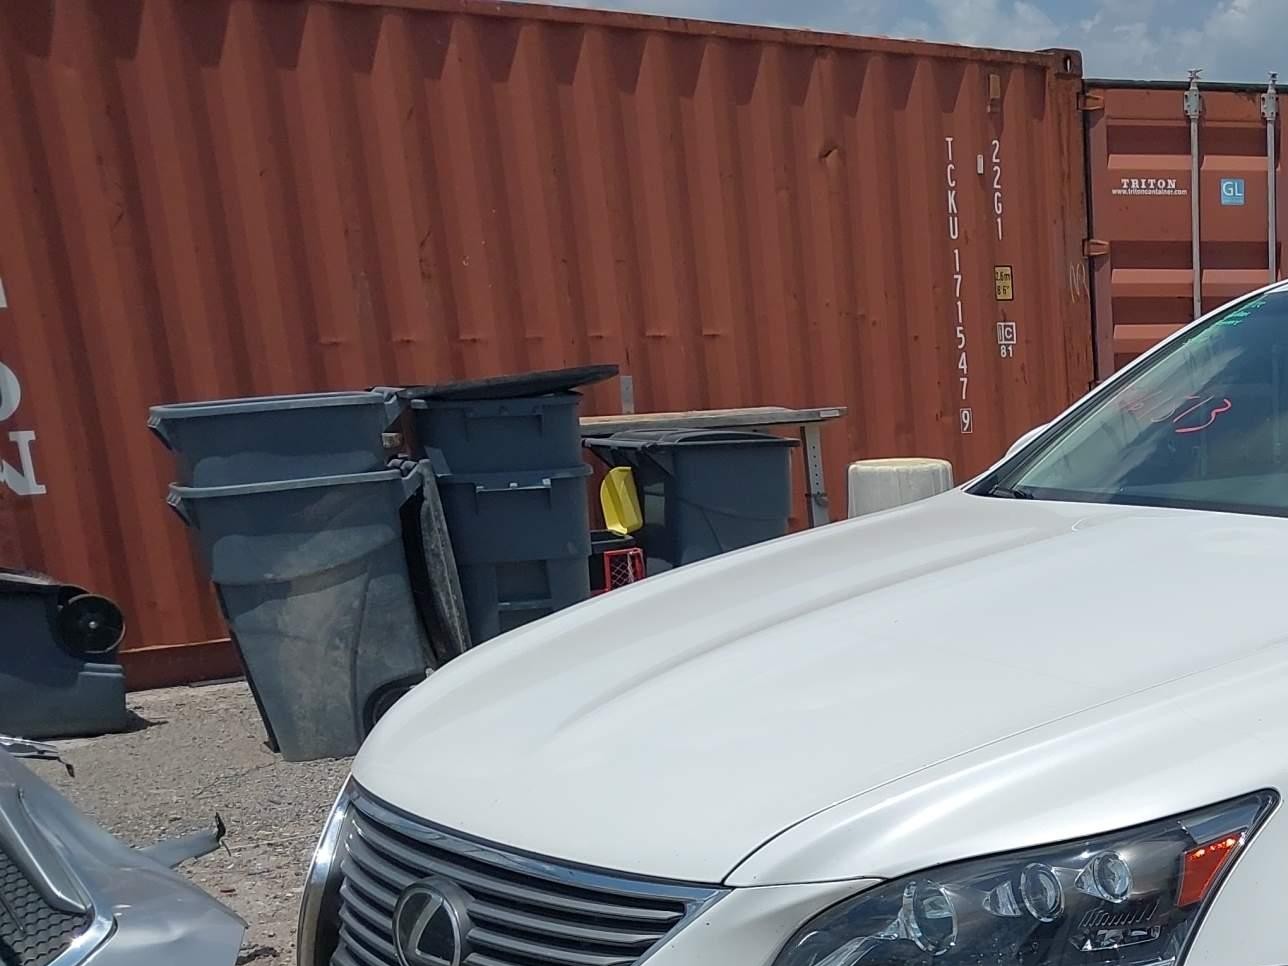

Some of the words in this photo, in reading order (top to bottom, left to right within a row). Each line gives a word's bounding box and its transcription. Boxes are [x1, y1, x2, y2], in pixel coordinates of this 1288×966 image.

[991, 139, 1003, 241] 22G1
[1120, 179, 1177, 189] TRITON
[1222, 181, 1243, 196] GL
[1000, 345, 1013, 358] 81
